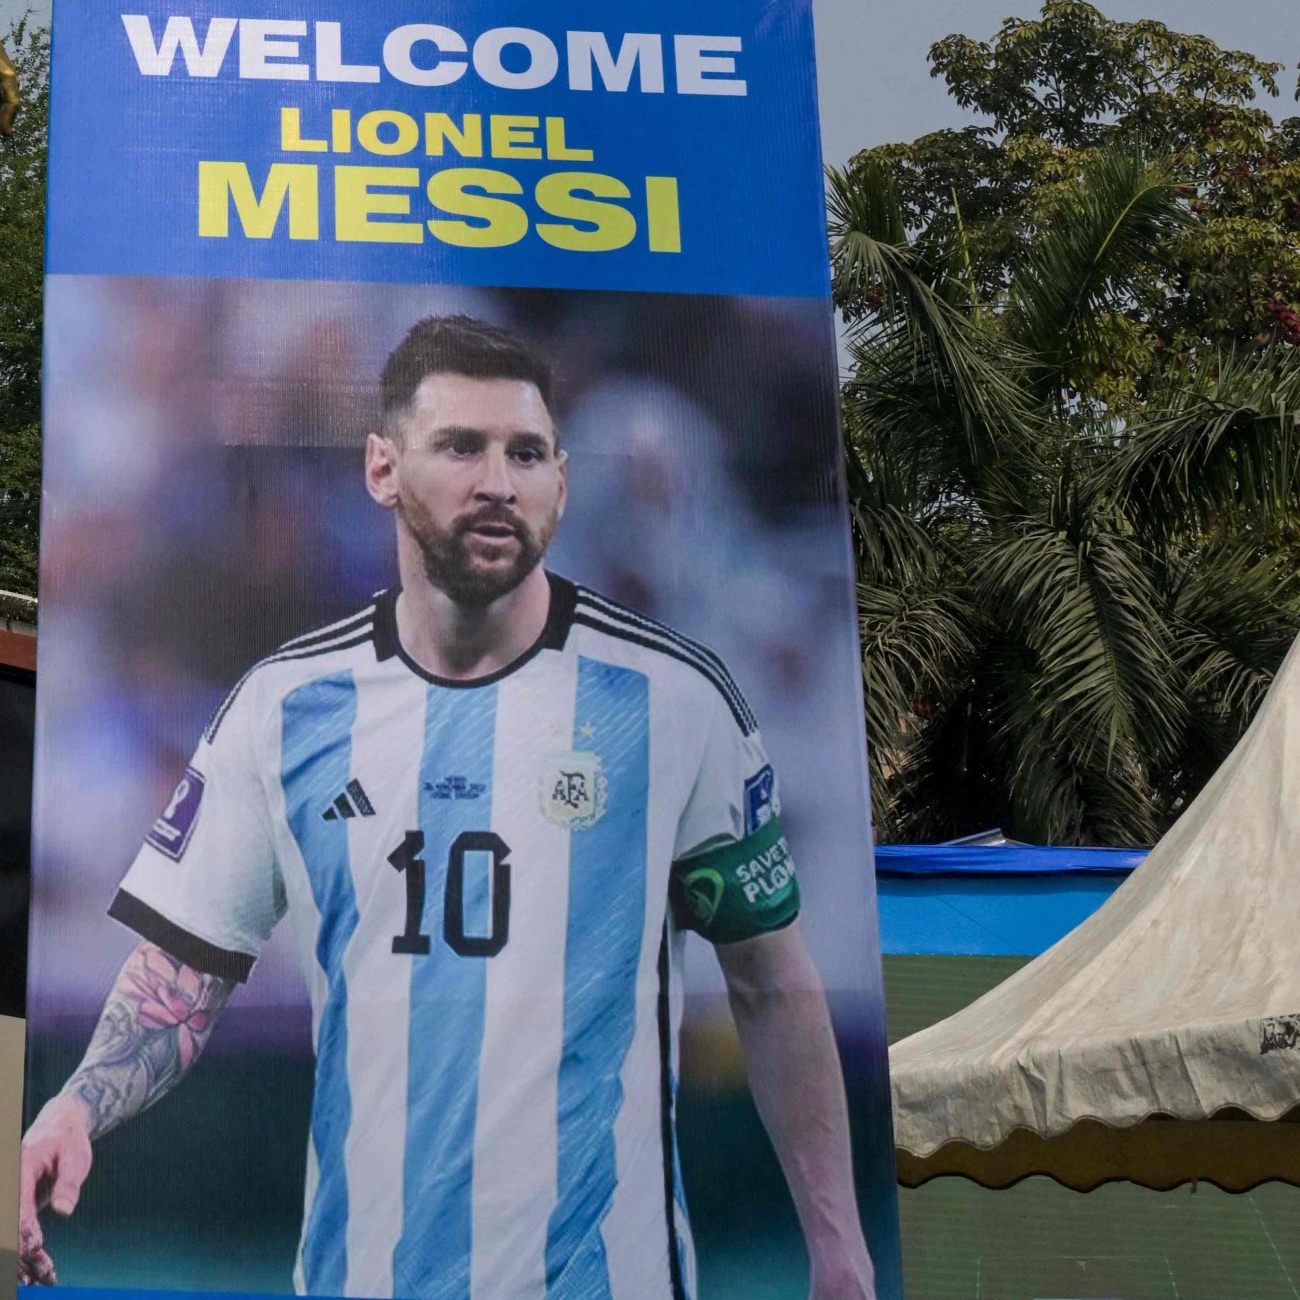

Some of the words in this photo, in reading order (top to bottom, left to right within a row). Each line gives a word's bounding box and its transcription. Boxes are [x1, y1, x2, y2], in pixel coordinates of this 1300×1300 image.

[121, 14, 747, 96] WELCOME
[281, 106, 594, 162] LIONEL
[198, 161, 682, 253] MESSI
[387, 830, 512, 957] 10
[736, 845, 781, 882] SAVE
